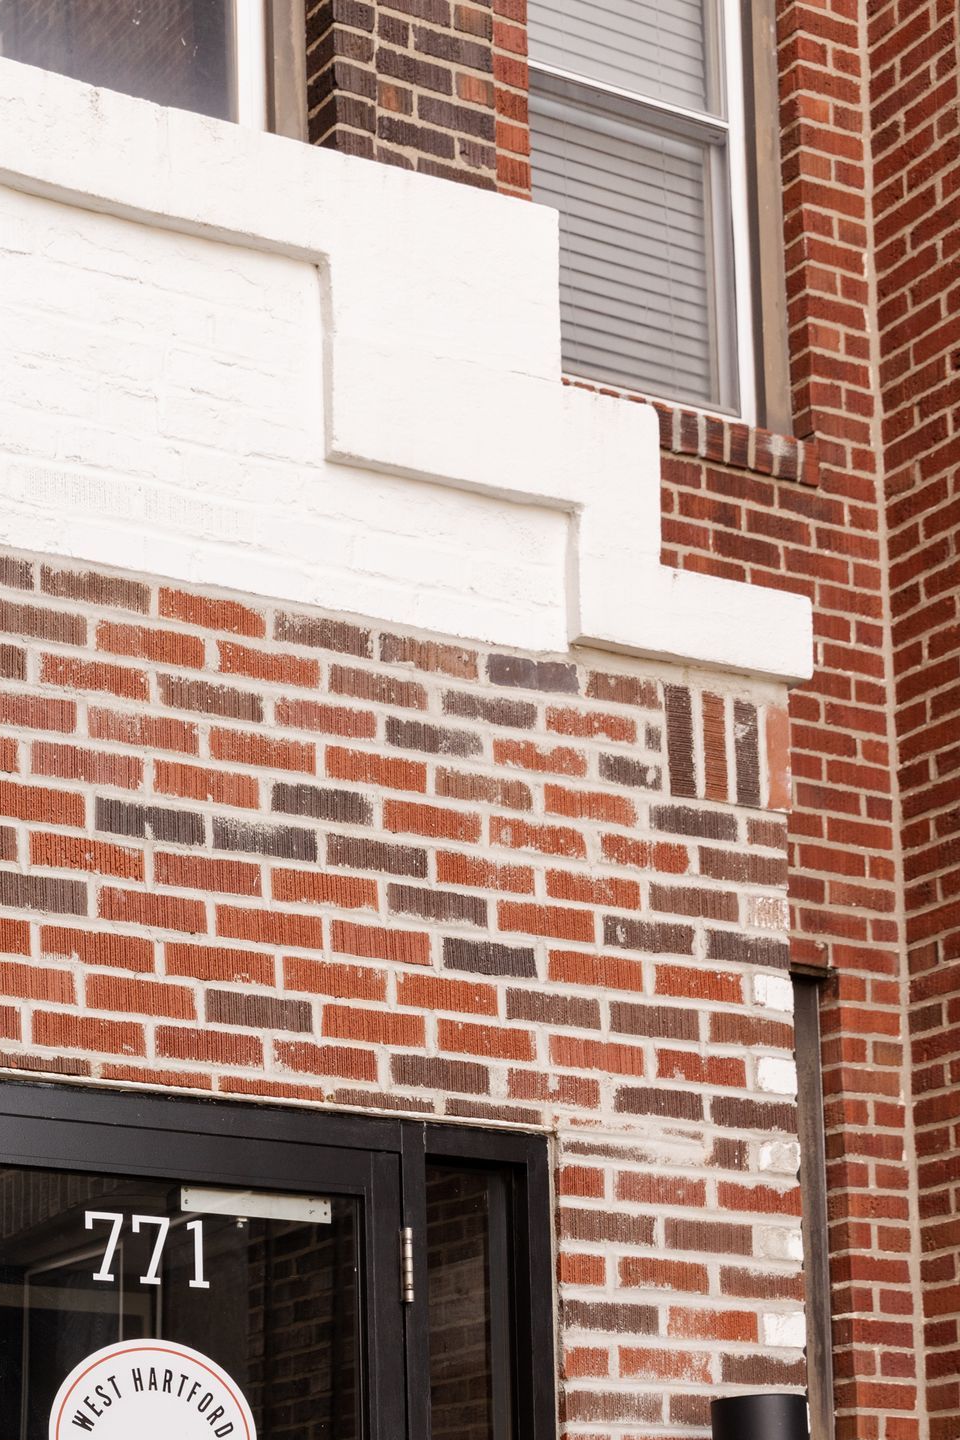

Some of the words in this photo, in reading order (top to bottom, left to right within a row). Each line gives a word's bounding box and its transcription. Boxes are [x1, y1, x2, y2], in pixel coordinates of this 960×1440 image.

[85, 1211, 210, 1289] 771
[72, 1375, 123, 1432] WEST
[132, 1367, 234, 1439] HARTFORD
